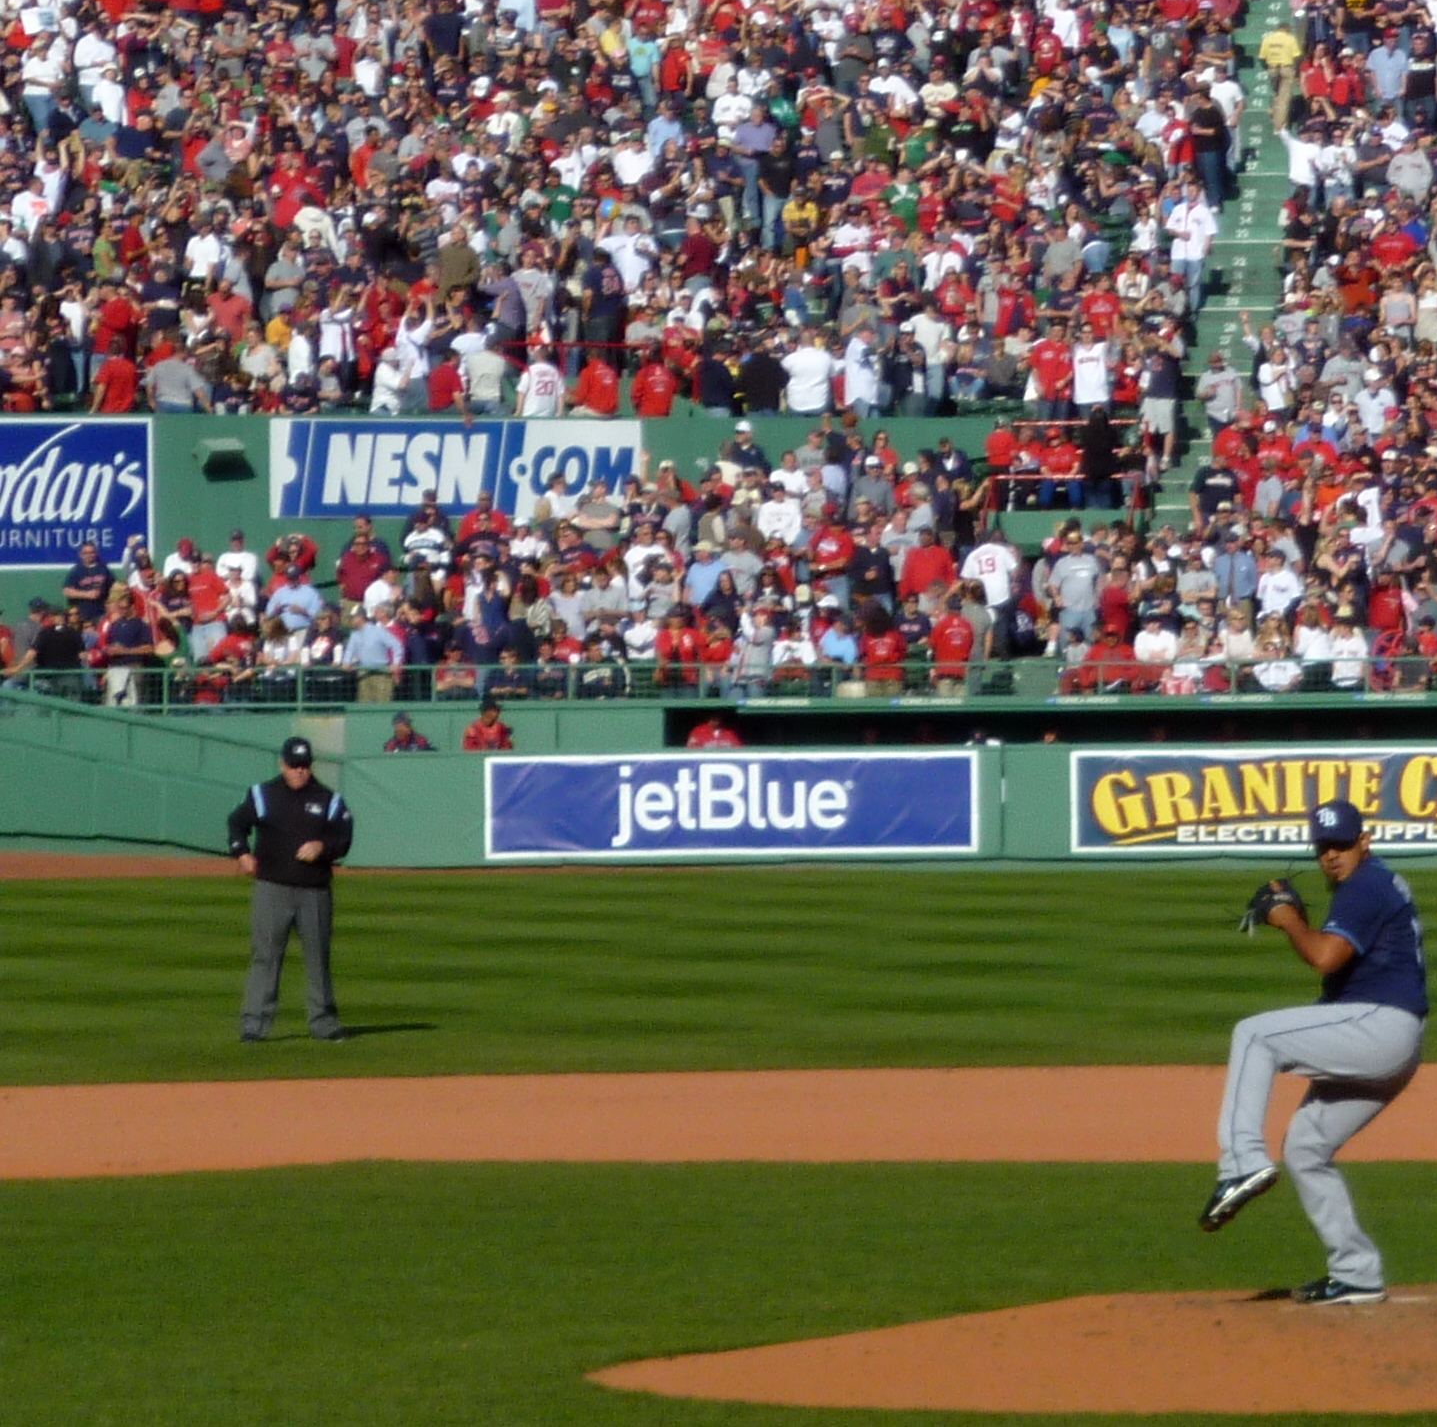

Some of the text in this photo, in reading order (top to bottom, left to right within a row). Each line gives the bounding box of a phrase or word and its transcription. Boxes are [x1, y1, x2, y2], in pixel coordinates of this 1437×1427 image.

[536, 380, 554, 396] 20
[321, 432, 488, 505] NESN
[978, 557, 996, 575] 19
[610, 763, 848, 848] jetBlue
[1090, 758, 1382, 836] GRANITE
[1316, 807, 1337, 827] TB
[1176, 824, 1311, 843] ELECTRI
